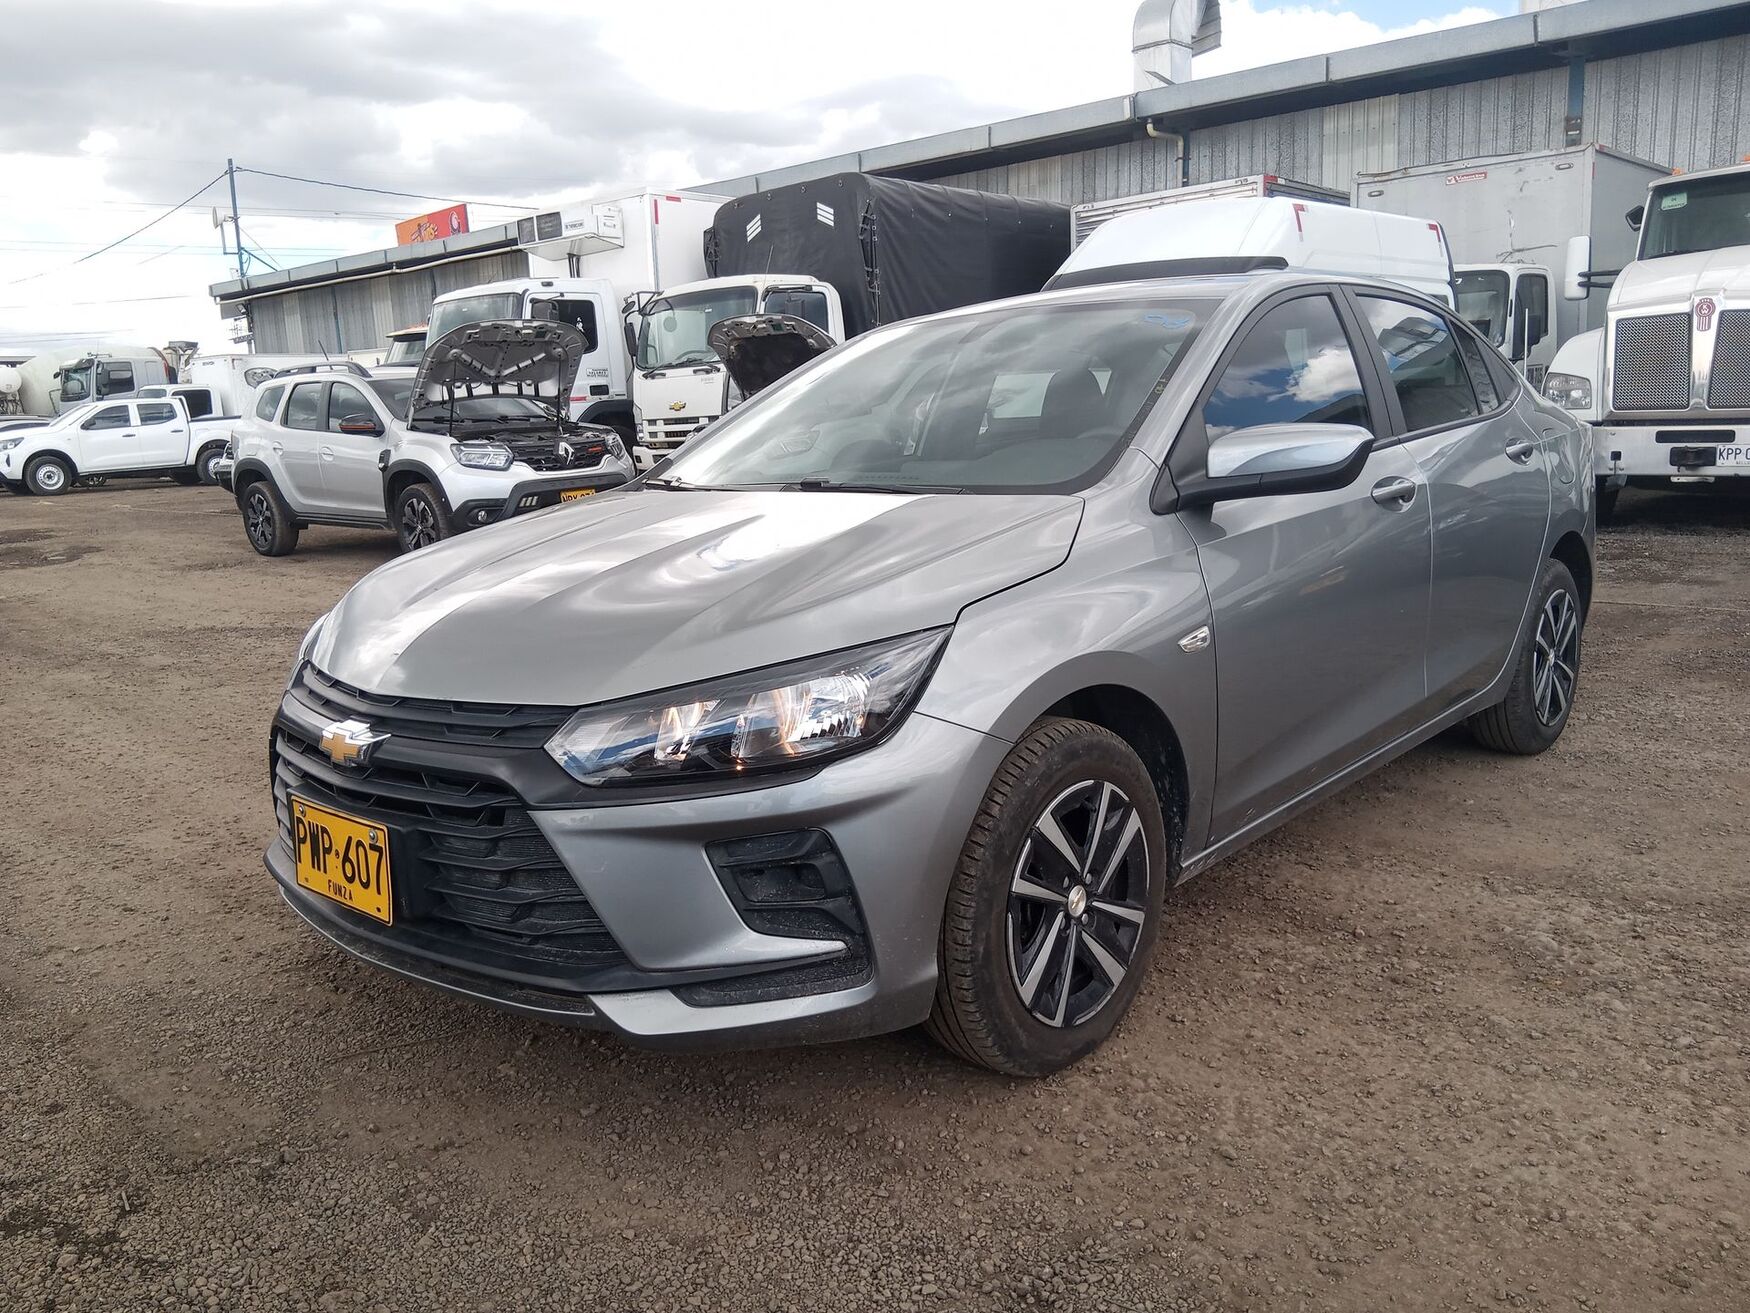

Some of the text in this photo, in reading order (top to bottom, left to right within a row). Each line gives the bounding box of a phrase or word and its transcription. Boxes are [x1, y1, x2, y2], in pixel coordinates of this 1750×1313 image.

[1719, 448, 1742, 460] KPP
[296, 815, 384, 895] PWP 607
[328, 880, 354, 902] FUNZA
